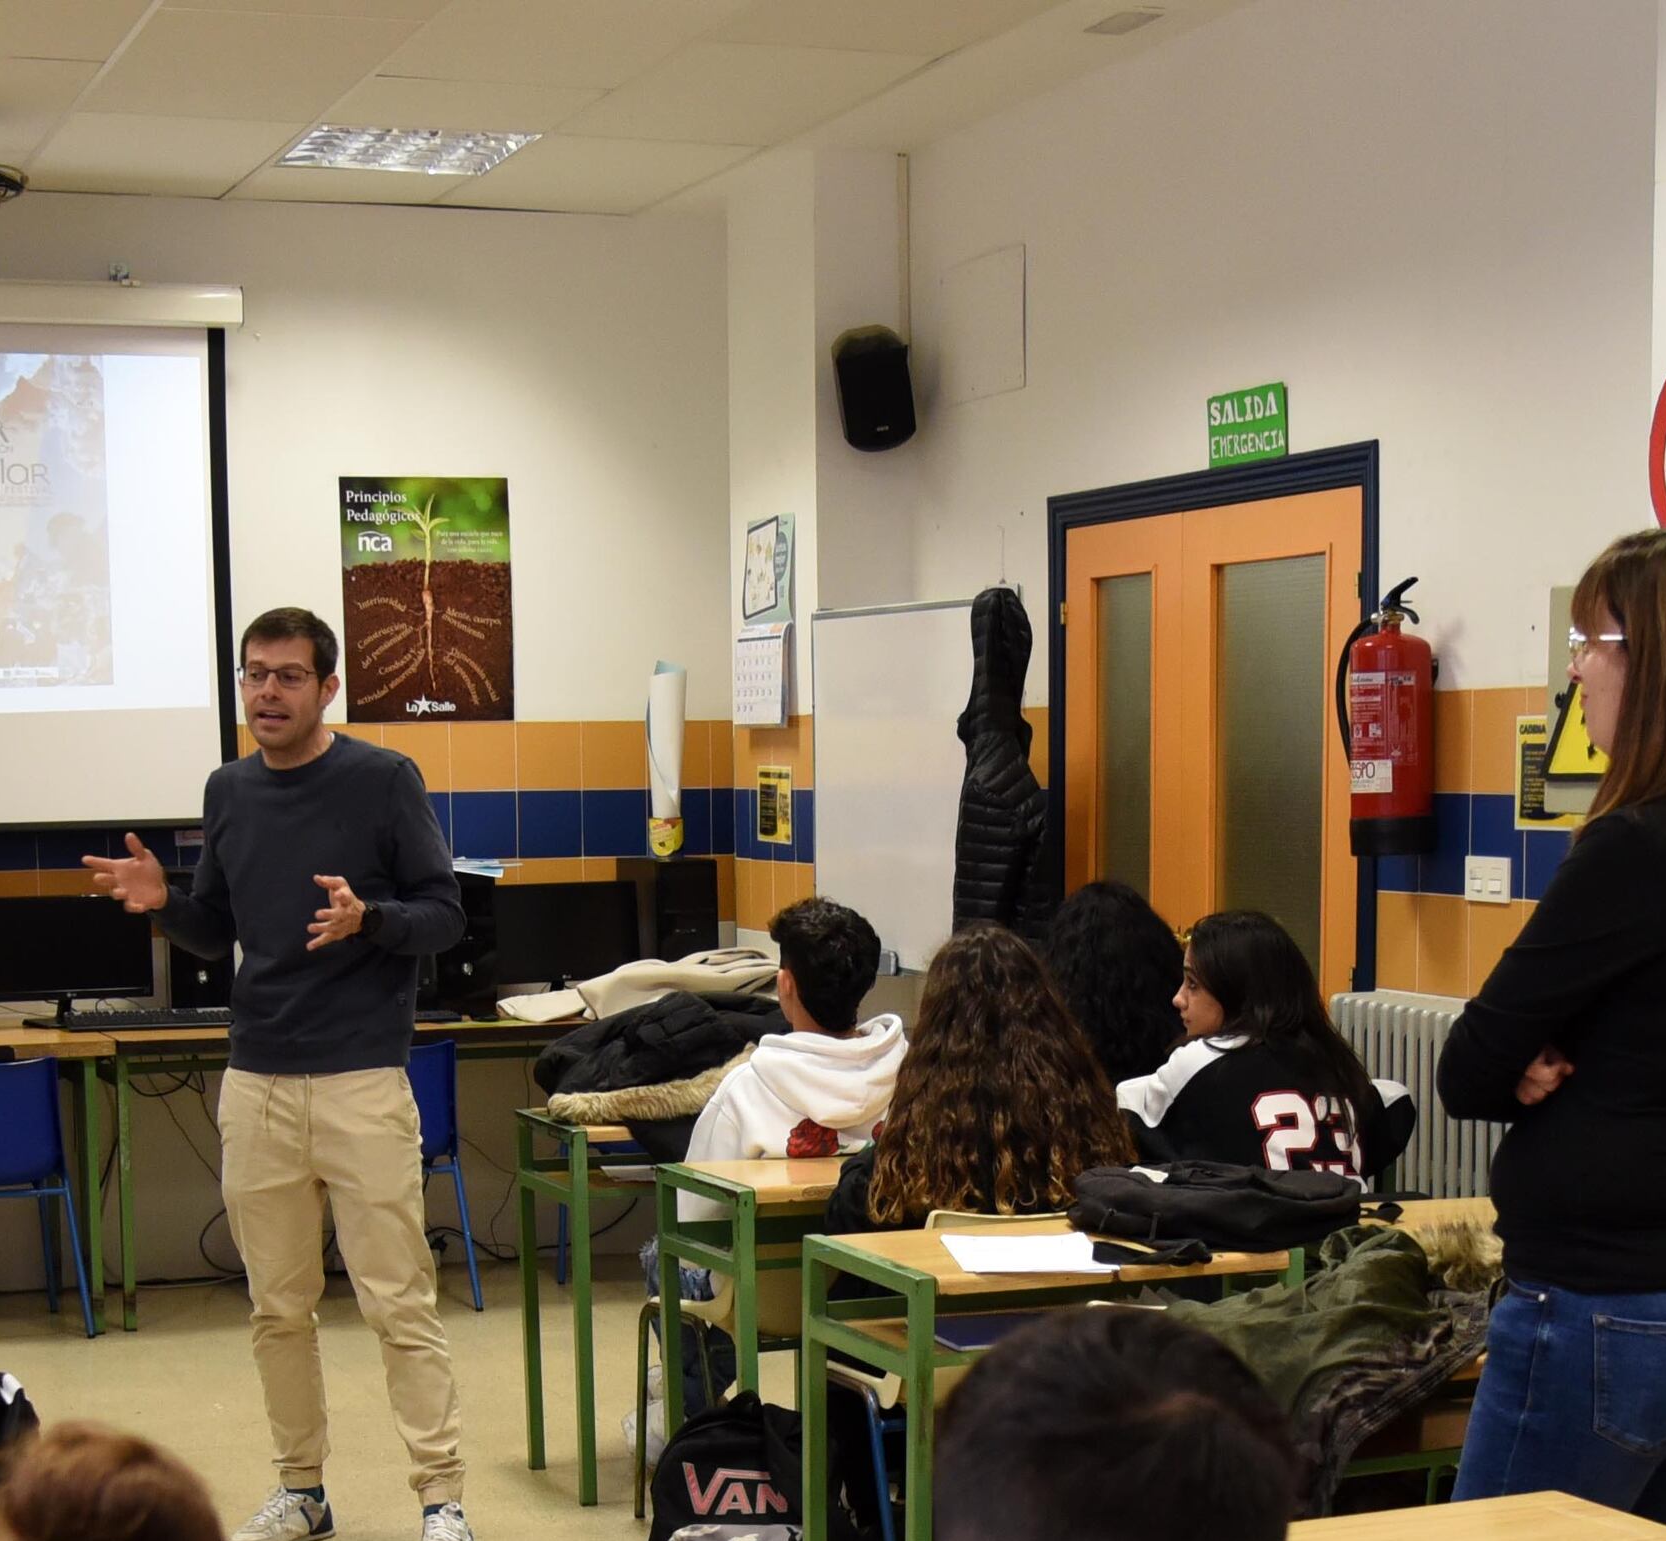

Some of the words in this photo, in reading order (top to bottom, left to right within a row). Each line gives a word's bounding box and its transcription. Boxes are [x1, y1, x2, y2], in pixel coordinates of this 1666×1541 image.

[1210, 391, 1278, 426] SALIDA
[1211, 429, 1284, 459] EMERGENCIA
[346, 490, 407, 506] Principios
[347, 509, 421, 525] Pedagógicos
[358, 532, 393, 552] nca
[406, 702, 418, 712] La
[431, 701, 456, 712] Salle
